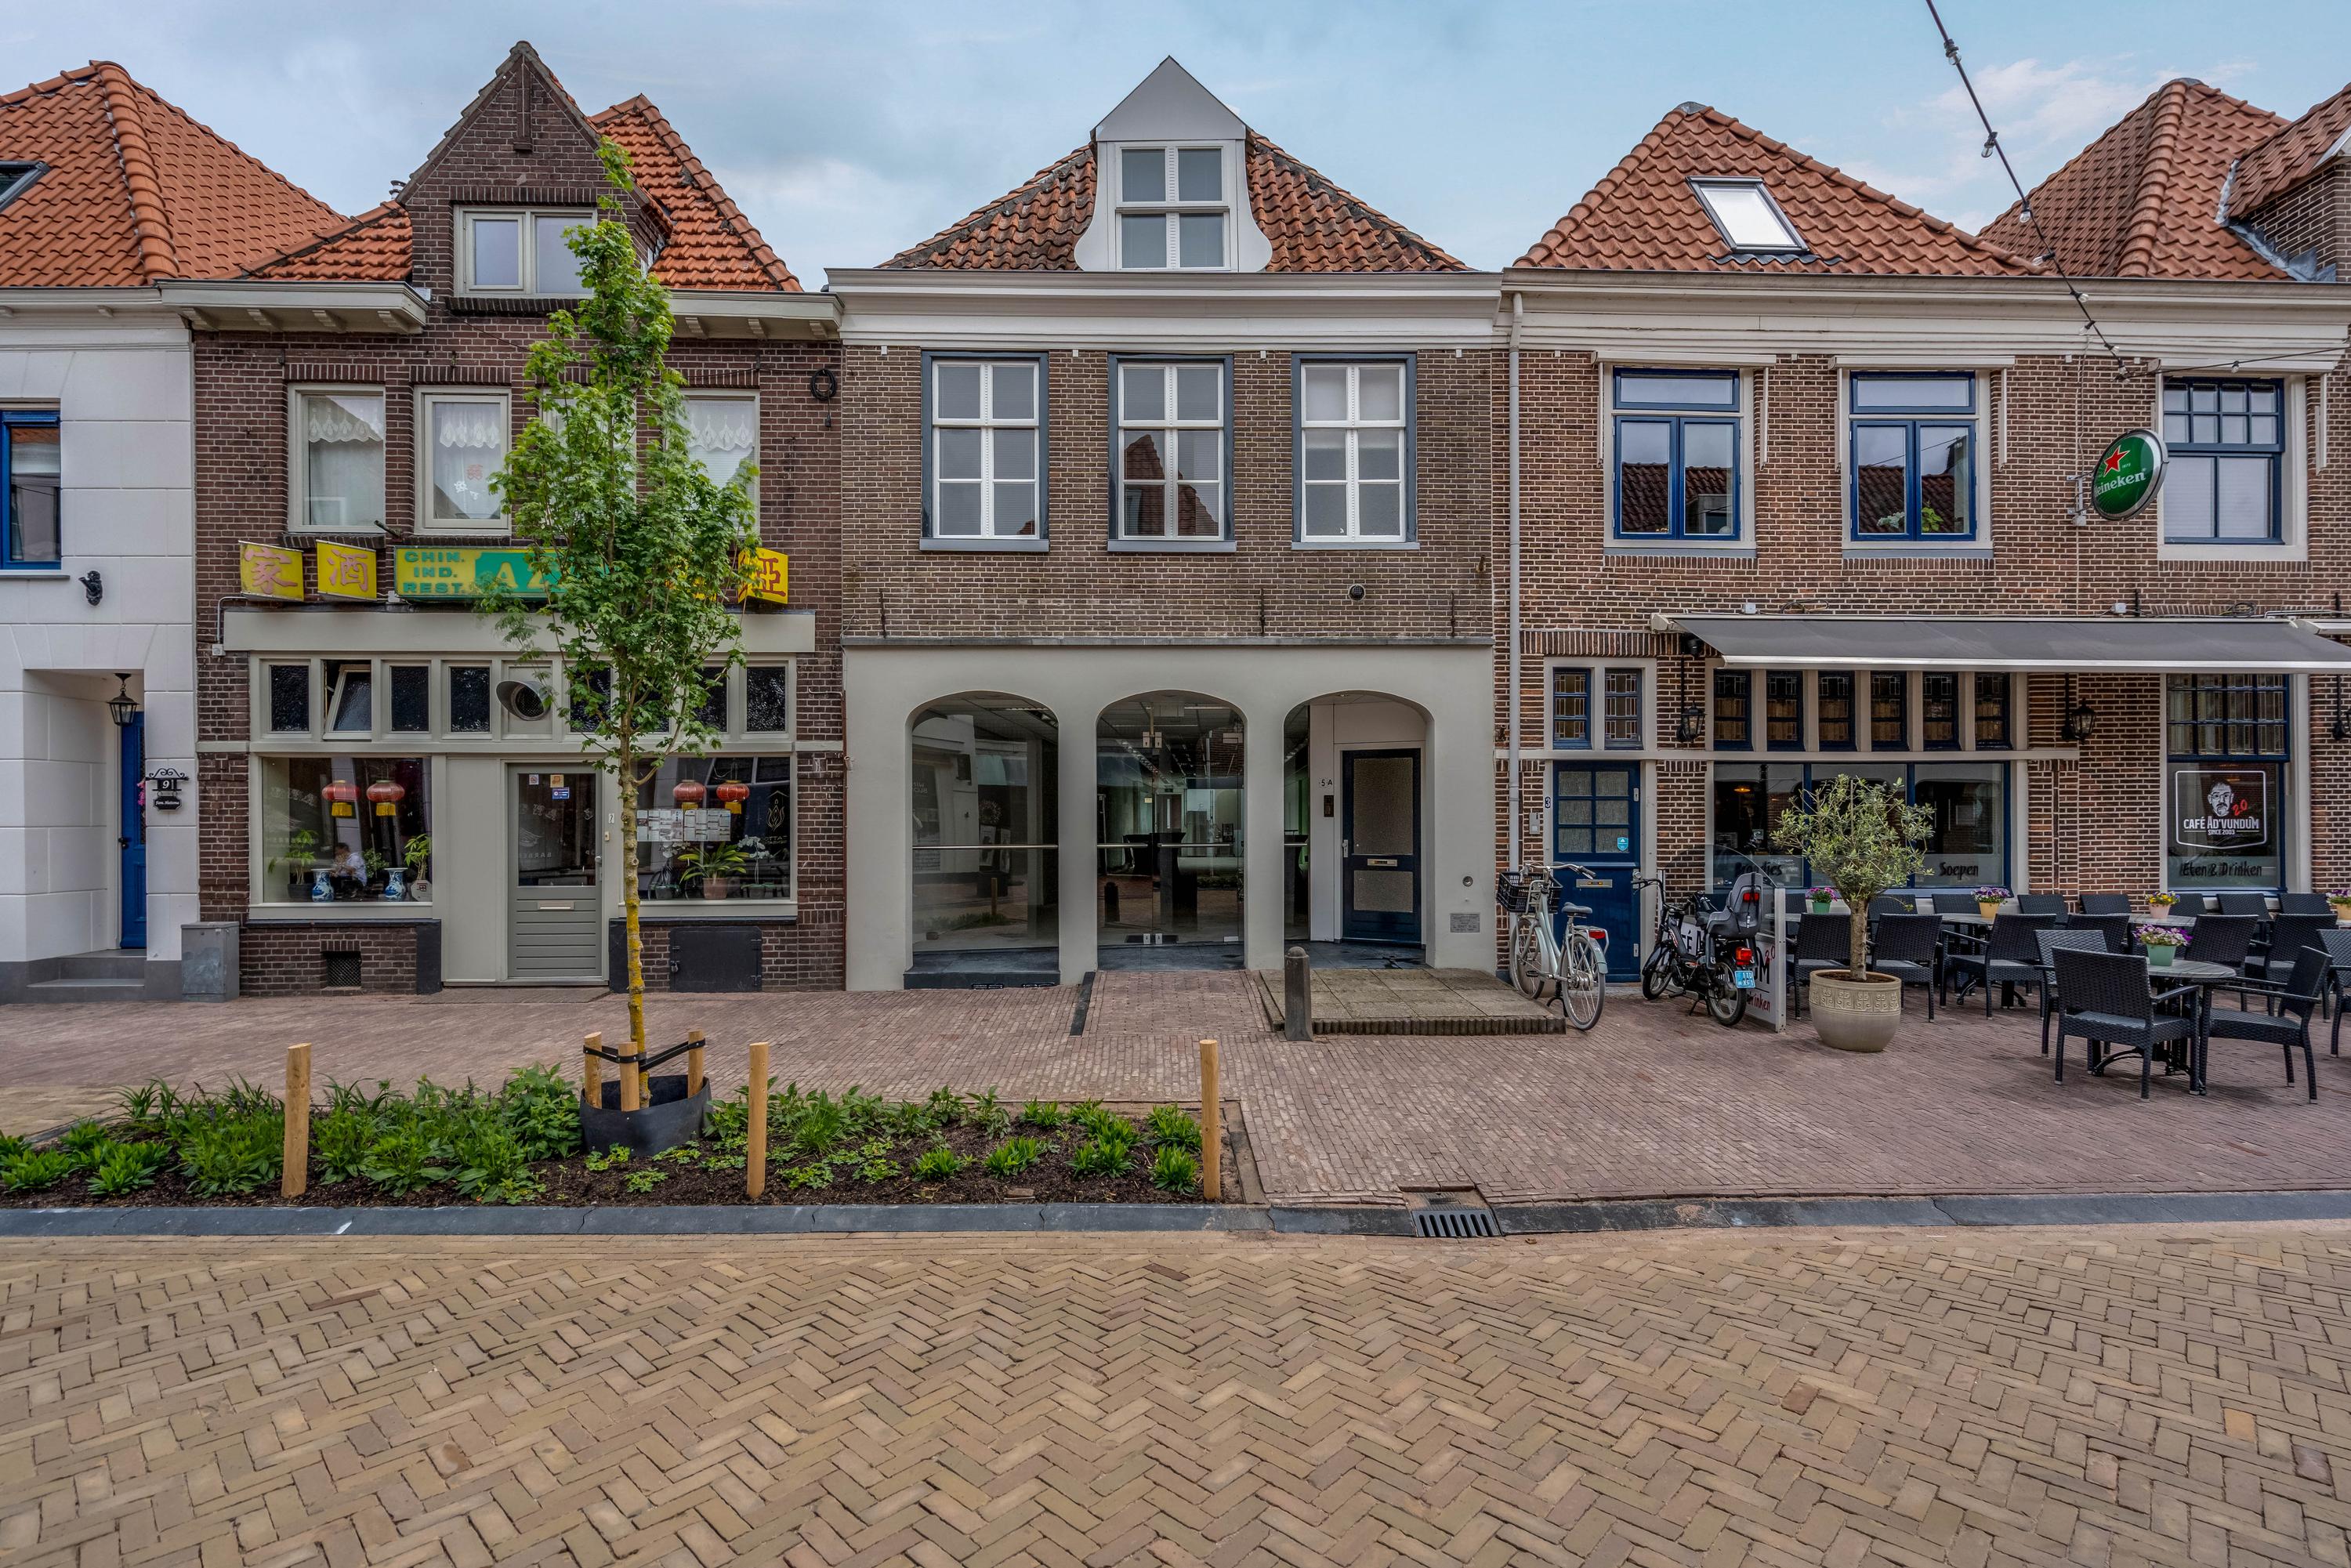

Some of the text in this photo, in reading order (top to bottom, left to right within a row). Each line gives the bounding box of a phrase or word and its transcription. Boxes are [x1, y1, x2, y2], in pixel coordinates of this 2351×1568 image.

[404, 551, 465, 563] CHIN.
[244, 547, 298, 594] 家
[327, 549, 368, 592] 酒
[414, 567, 457, 578] IND.
[403, 582, 465, 593] REST.
[162, 780, 169, 789] 9
[1545, 796, 1551, 808] 3
[2183, 817, 2205, 829] CAFÉ
[1940, 862, 1978, 881] Soepen
[2181, 861, 2262, 877] Eten & Drinken
